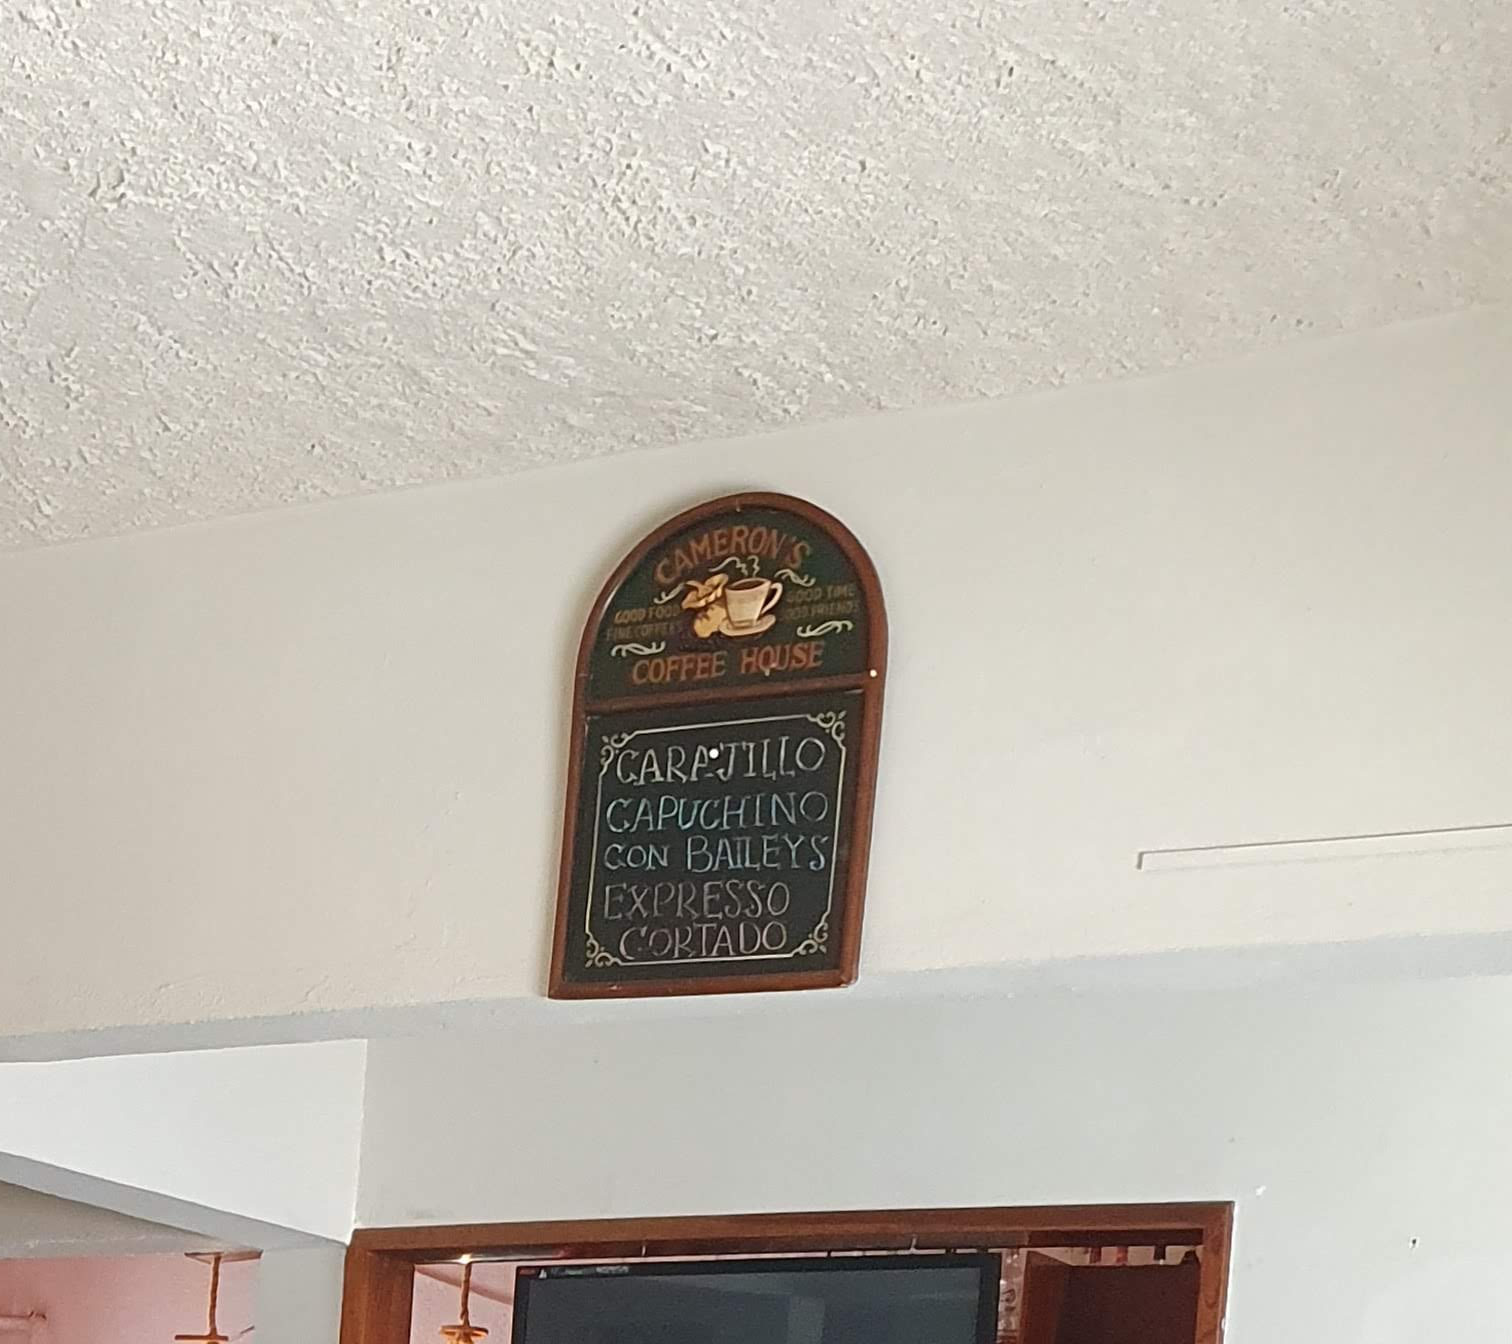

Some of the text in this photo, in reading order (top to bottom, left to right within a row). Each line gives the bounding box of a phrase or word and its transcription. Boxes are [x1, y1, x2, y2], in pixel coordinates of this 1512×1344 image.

[654, 525, 811, 585] CAMERON'S
[614, 608, 646, 624] GOOD
[632, 640, 825, 685] COFFEE HOUSE
[616, 736, 826, 786] CARAJILLO
[606, 791, 829, 833] CAPUCHINO
[604, 834, 830, 873] CON BAILEYS
[604, 879, 790, 921] EXPRESSO
[619, 920, 787, 960] CORTADO
